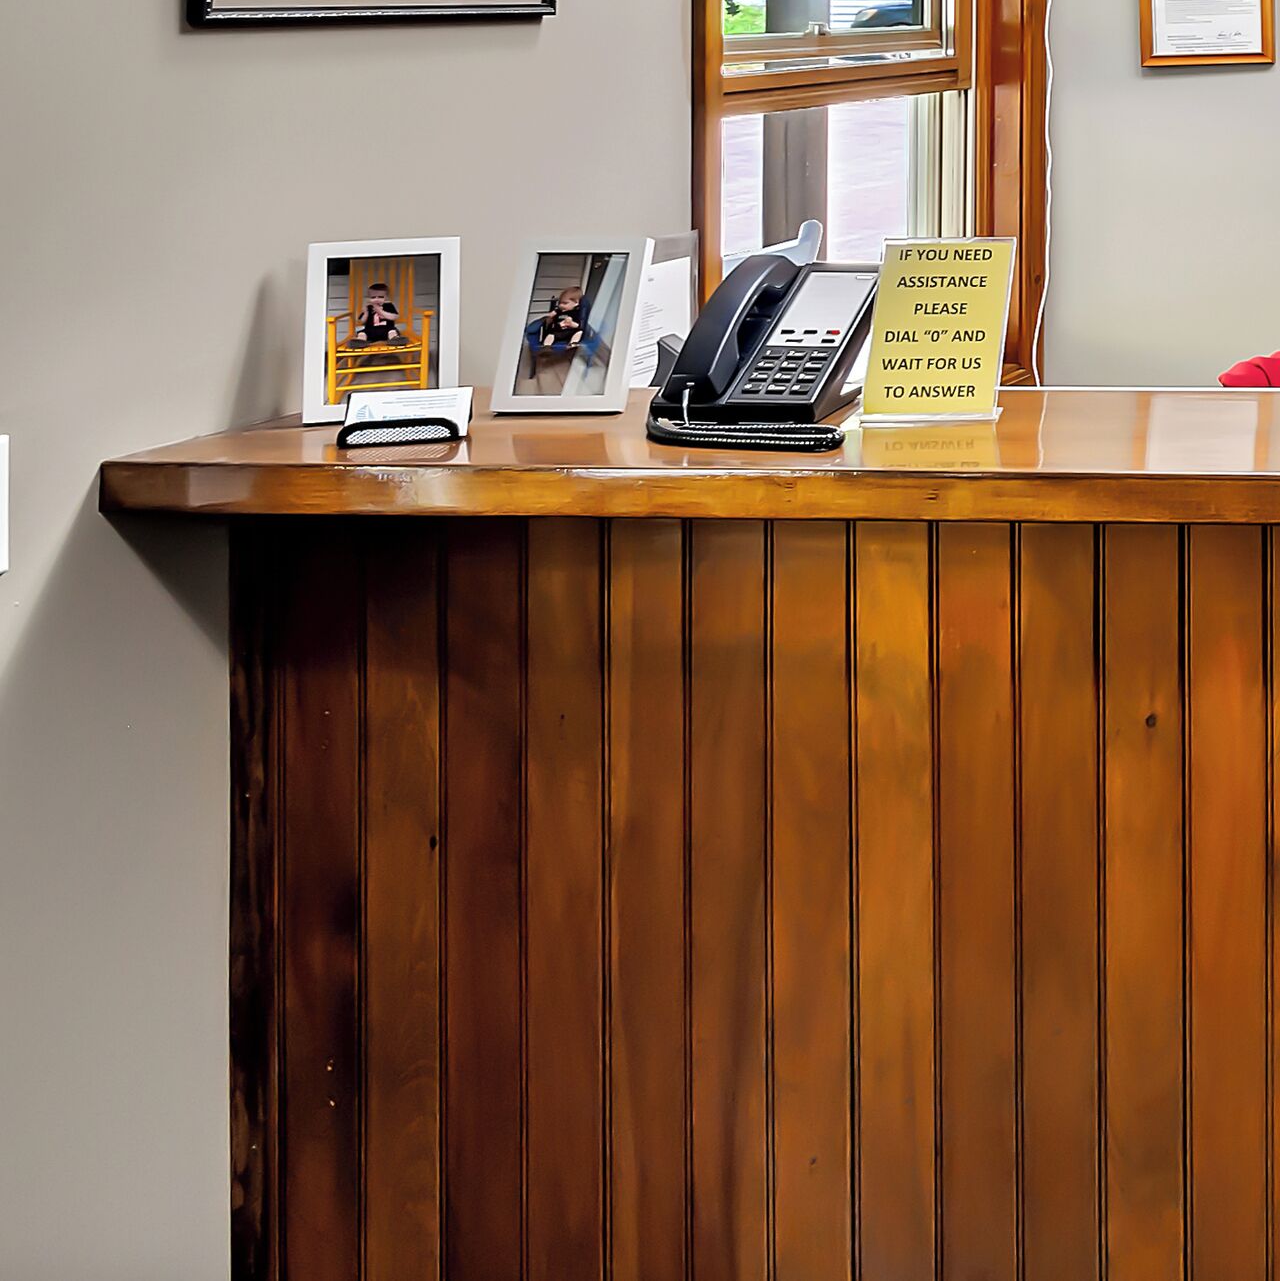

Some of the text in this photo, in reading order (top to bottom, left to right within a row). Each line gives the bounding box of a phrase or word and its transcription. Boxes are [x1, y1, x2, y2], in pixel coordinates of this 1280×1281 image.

[900, 249, 993, 261] IF YOU NEED
[897, 276, 987, 288] ASSISTANCE
[914, 303, 968, 315] PLEASE
[884, 331, 918, 342] DIAL
[952, 330, 986, 342] AND
[882, 358, 981, 370] WAIT FOR US
[884, 385, 975, 398] TO ANSWER
